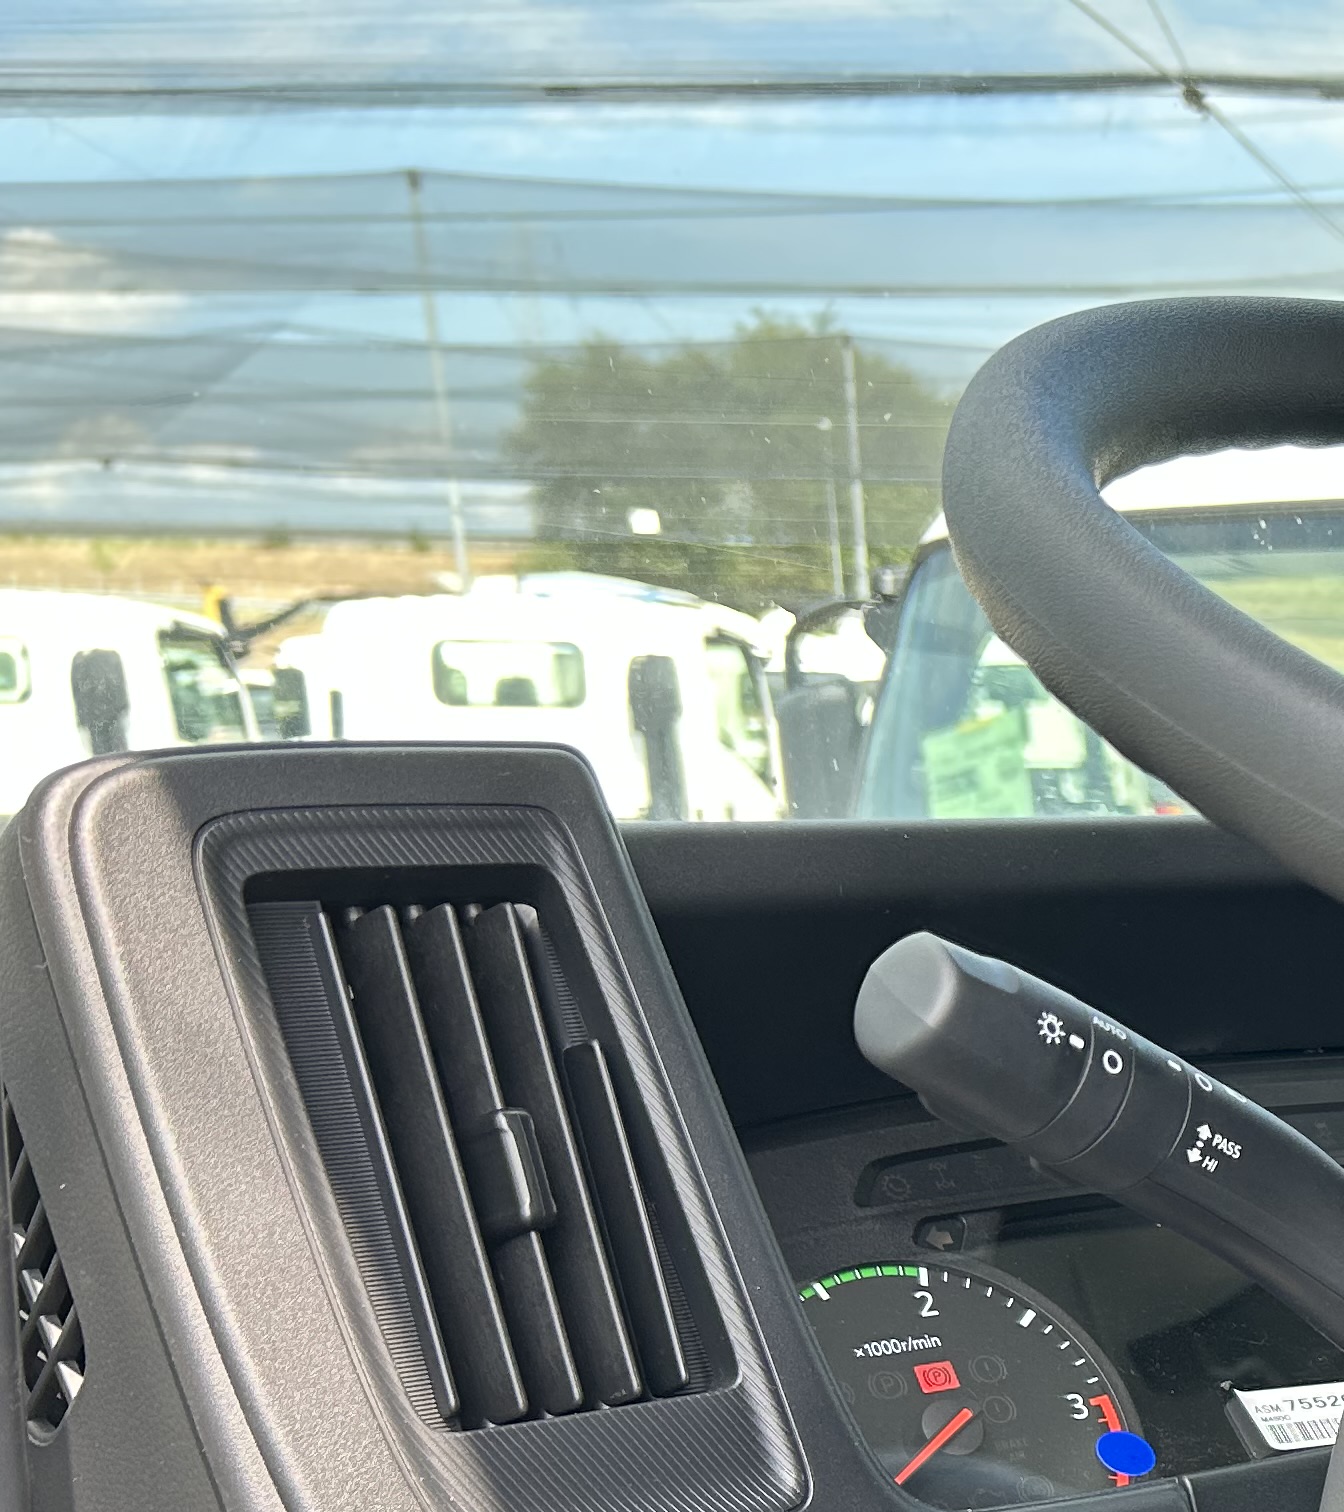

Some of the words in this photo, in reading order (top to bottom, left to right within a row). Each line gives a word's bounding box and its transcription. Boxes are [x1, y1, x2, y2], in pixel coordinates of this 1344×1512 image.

[1092, 1015, 1127, 1040] AUTO
[1211, 1133, 1242, 1159] PASS
[1201, 1155, 1219, 1173] HI
[913, 1290, 940, 1317] 2
[1065, 1393, 1089, 1420] 3
[1253, 1403, 1282, 1414] ASM
